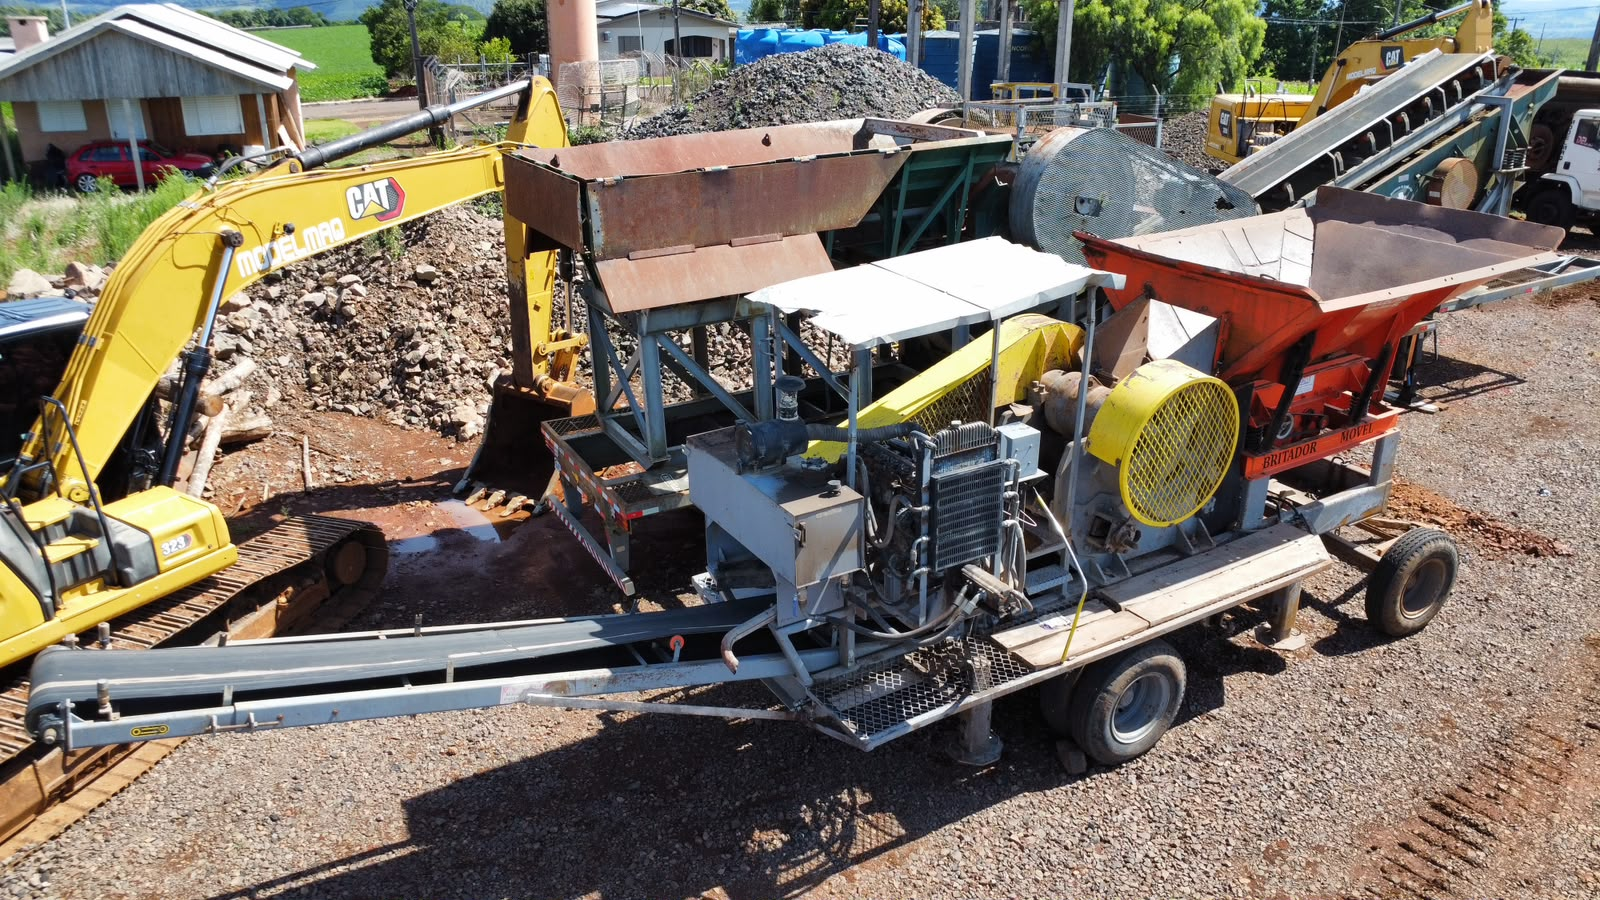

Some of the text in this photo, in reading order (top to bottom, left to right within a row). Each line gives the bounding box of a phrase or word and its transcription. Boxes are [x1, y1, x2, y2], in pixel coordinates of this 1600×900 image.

[1385, 49, 1400, 66] CAT
[346, 178, 390, 220] CAT
[236, 217, 346, 279] MODELMAQ
[1263, 423, 1374, 469] BRITADOR MOVEL
[161, 536, 185, 555] 323
